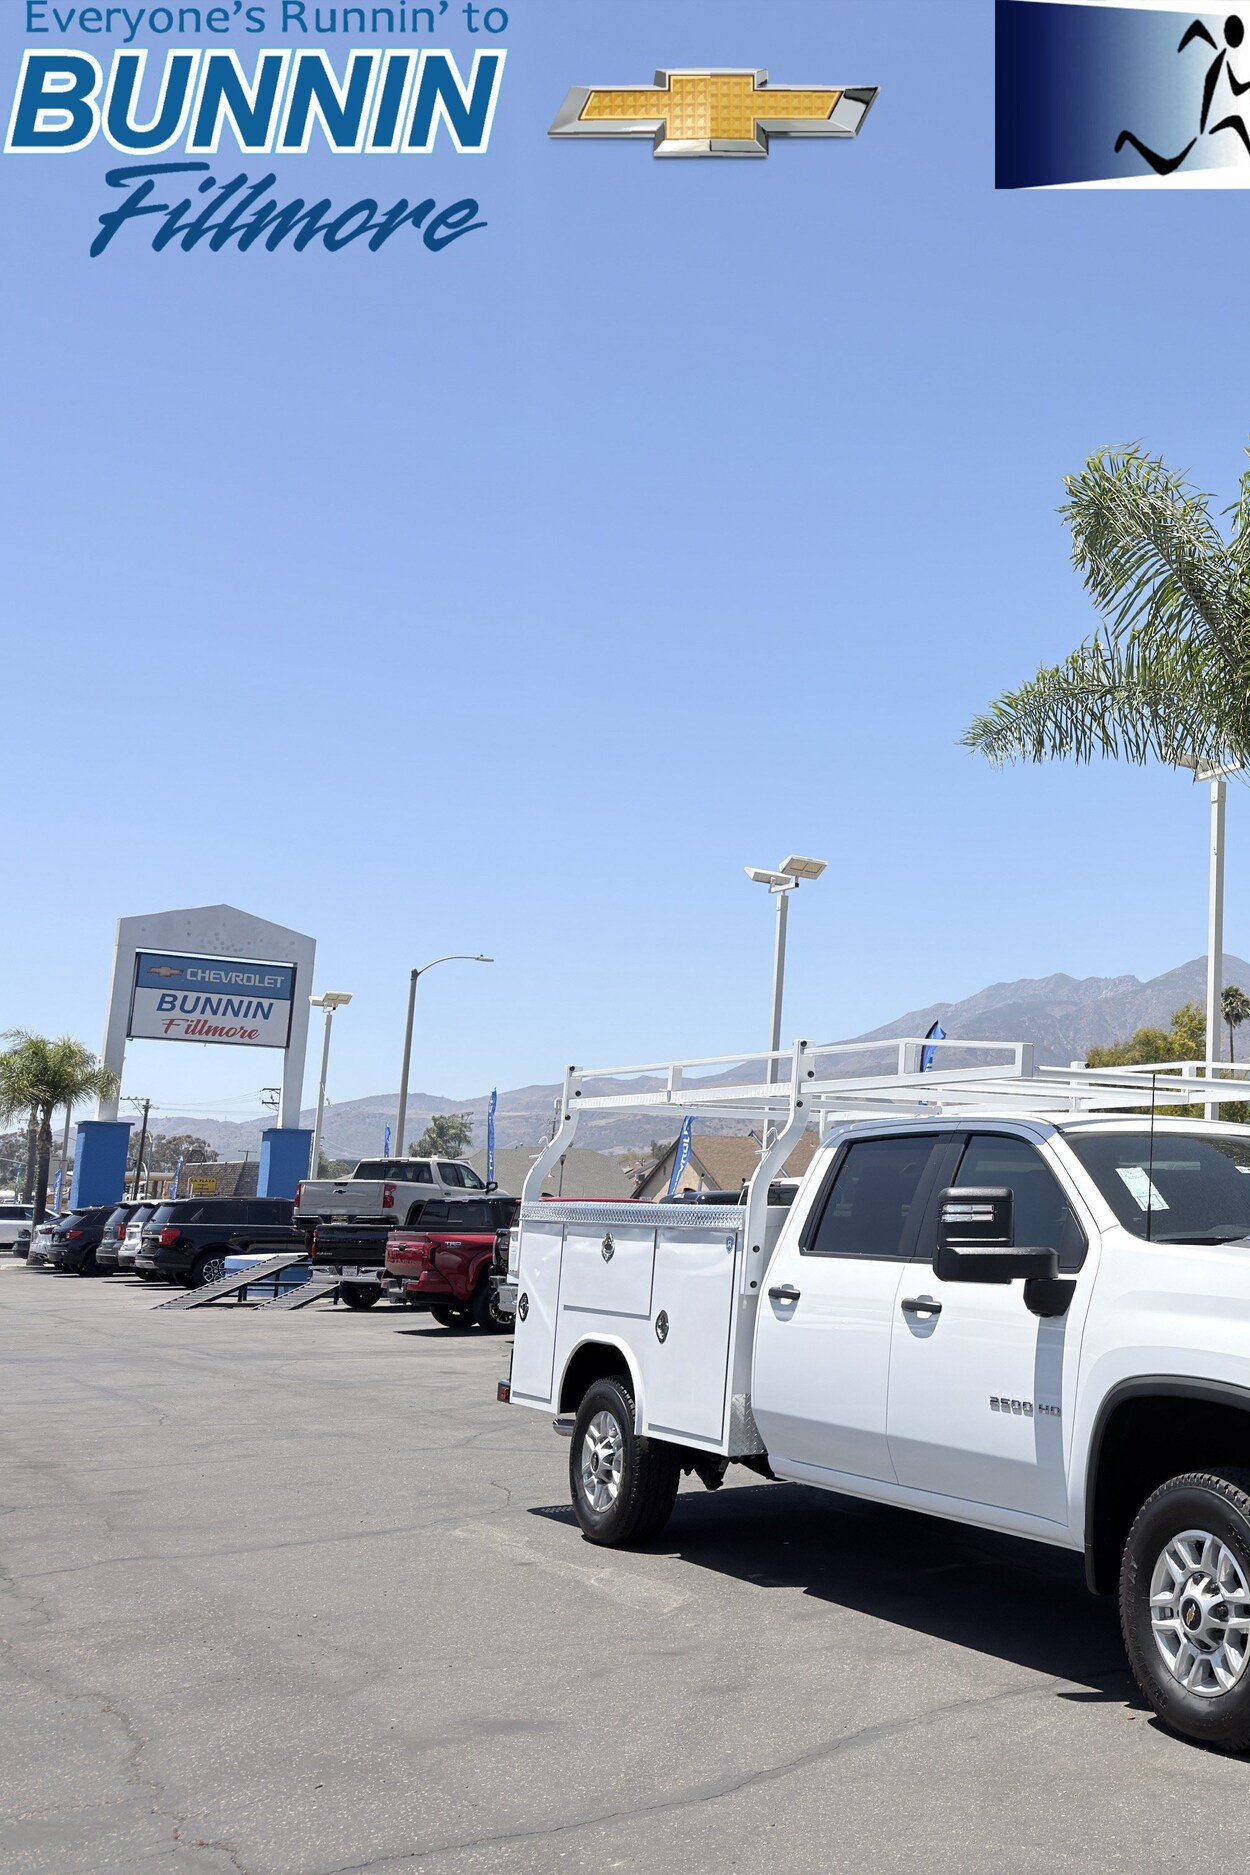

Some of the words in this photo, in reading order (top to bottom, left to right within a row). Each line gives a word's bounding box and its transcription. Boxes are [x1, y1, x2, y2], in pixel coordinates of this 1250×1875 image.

[186, 968, 285, 988] CHEVROLET
[156, 992, 274, 1020] BUNNIN
[161, 1018, 260, 1040] Fillmore
[989, 1396, 1034, 1416] 2500
[1038, 1404, 1061, 1416] HD
